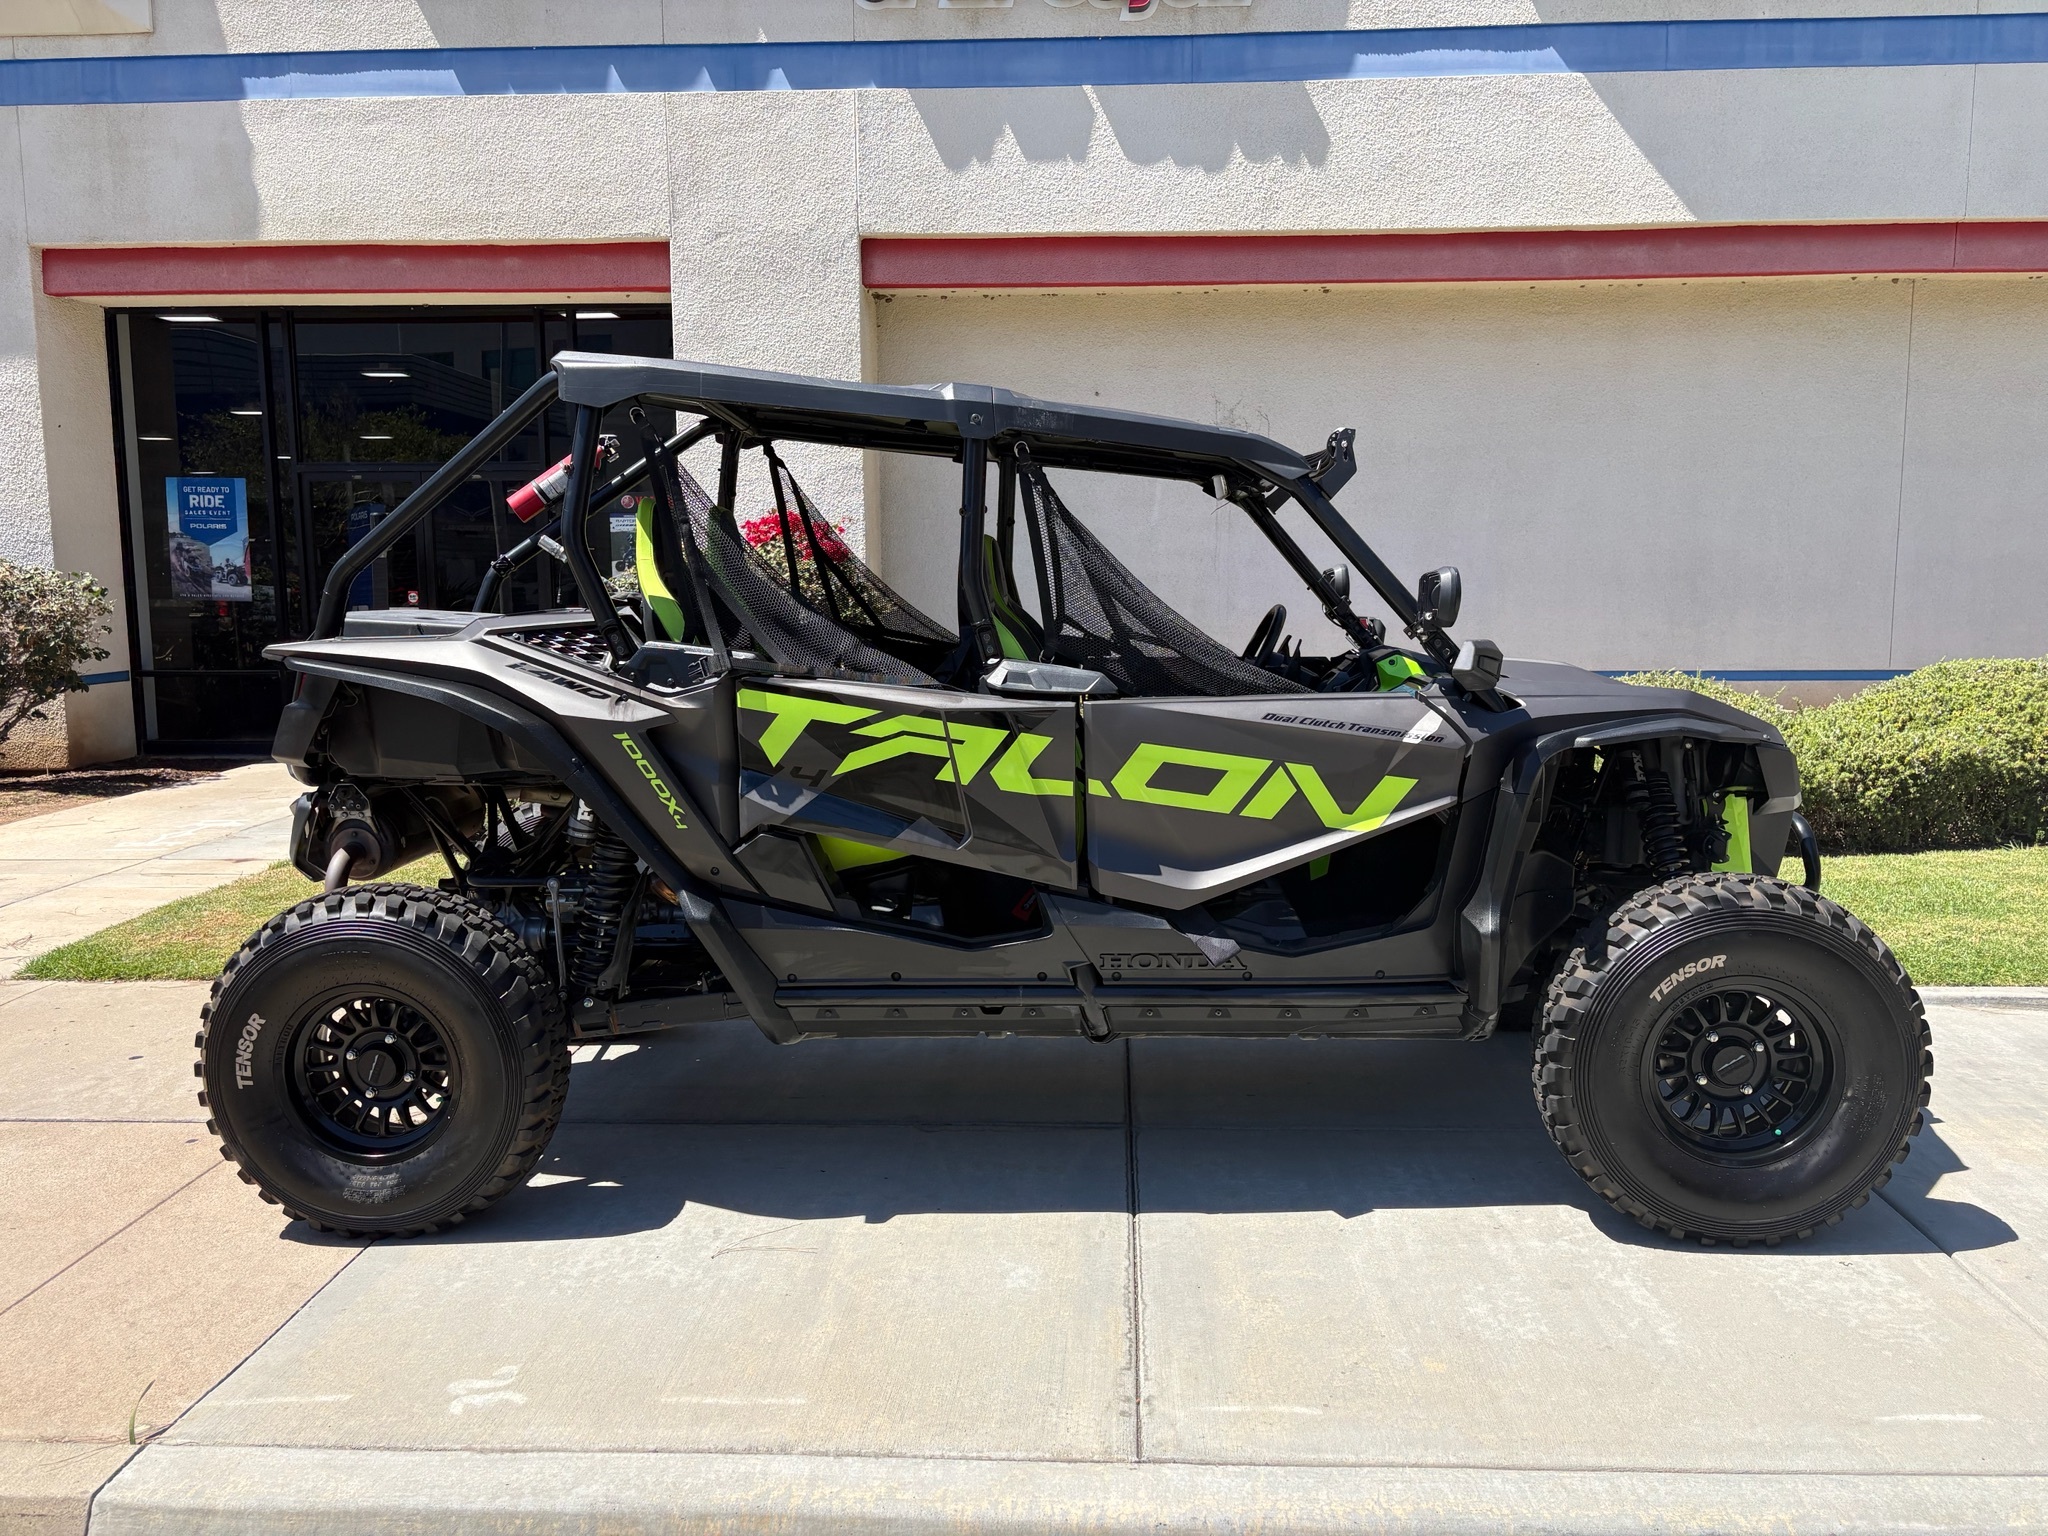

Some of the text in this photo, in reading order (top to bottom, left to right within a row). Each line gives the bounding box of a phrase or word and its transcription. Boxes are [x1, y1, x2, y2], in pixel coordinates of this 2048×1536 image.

[189, 494, 225, 508] RIDE
[1261, 712, 1446, 743] Dual Clutch Transmission
[737, 689, 1418, 832] TALON
[1099, 953, 1248, 970] HONDA
[1649, 954, 1727, 1003] TENSOR
[235, 1012, 267, 1090] TENSOR
